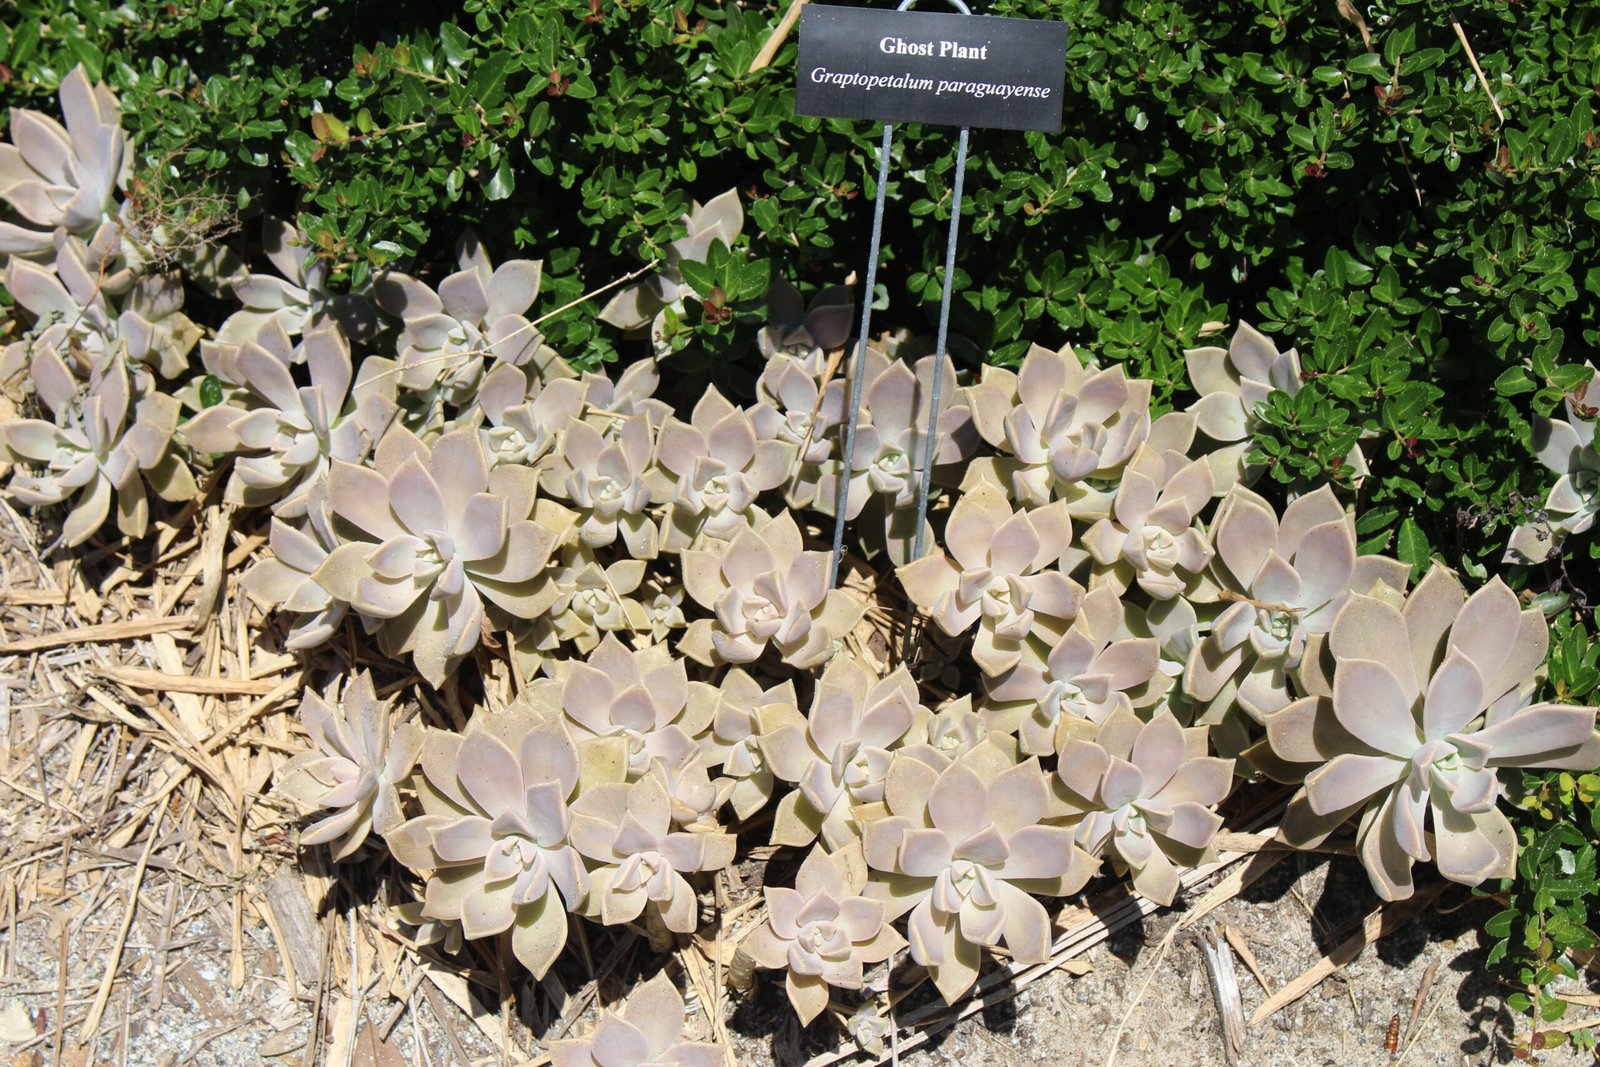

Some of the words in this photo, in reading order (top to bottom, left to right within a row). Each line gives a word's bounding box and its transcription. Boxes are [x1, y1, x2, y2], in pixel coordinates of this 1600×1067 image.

[879, 37, 935, 57] Ghost
[938, 40, 988, 60] Plant
[810, 67, 934, 91] Graptopetalum
[935, 80, 1051, 100] paraguayense
